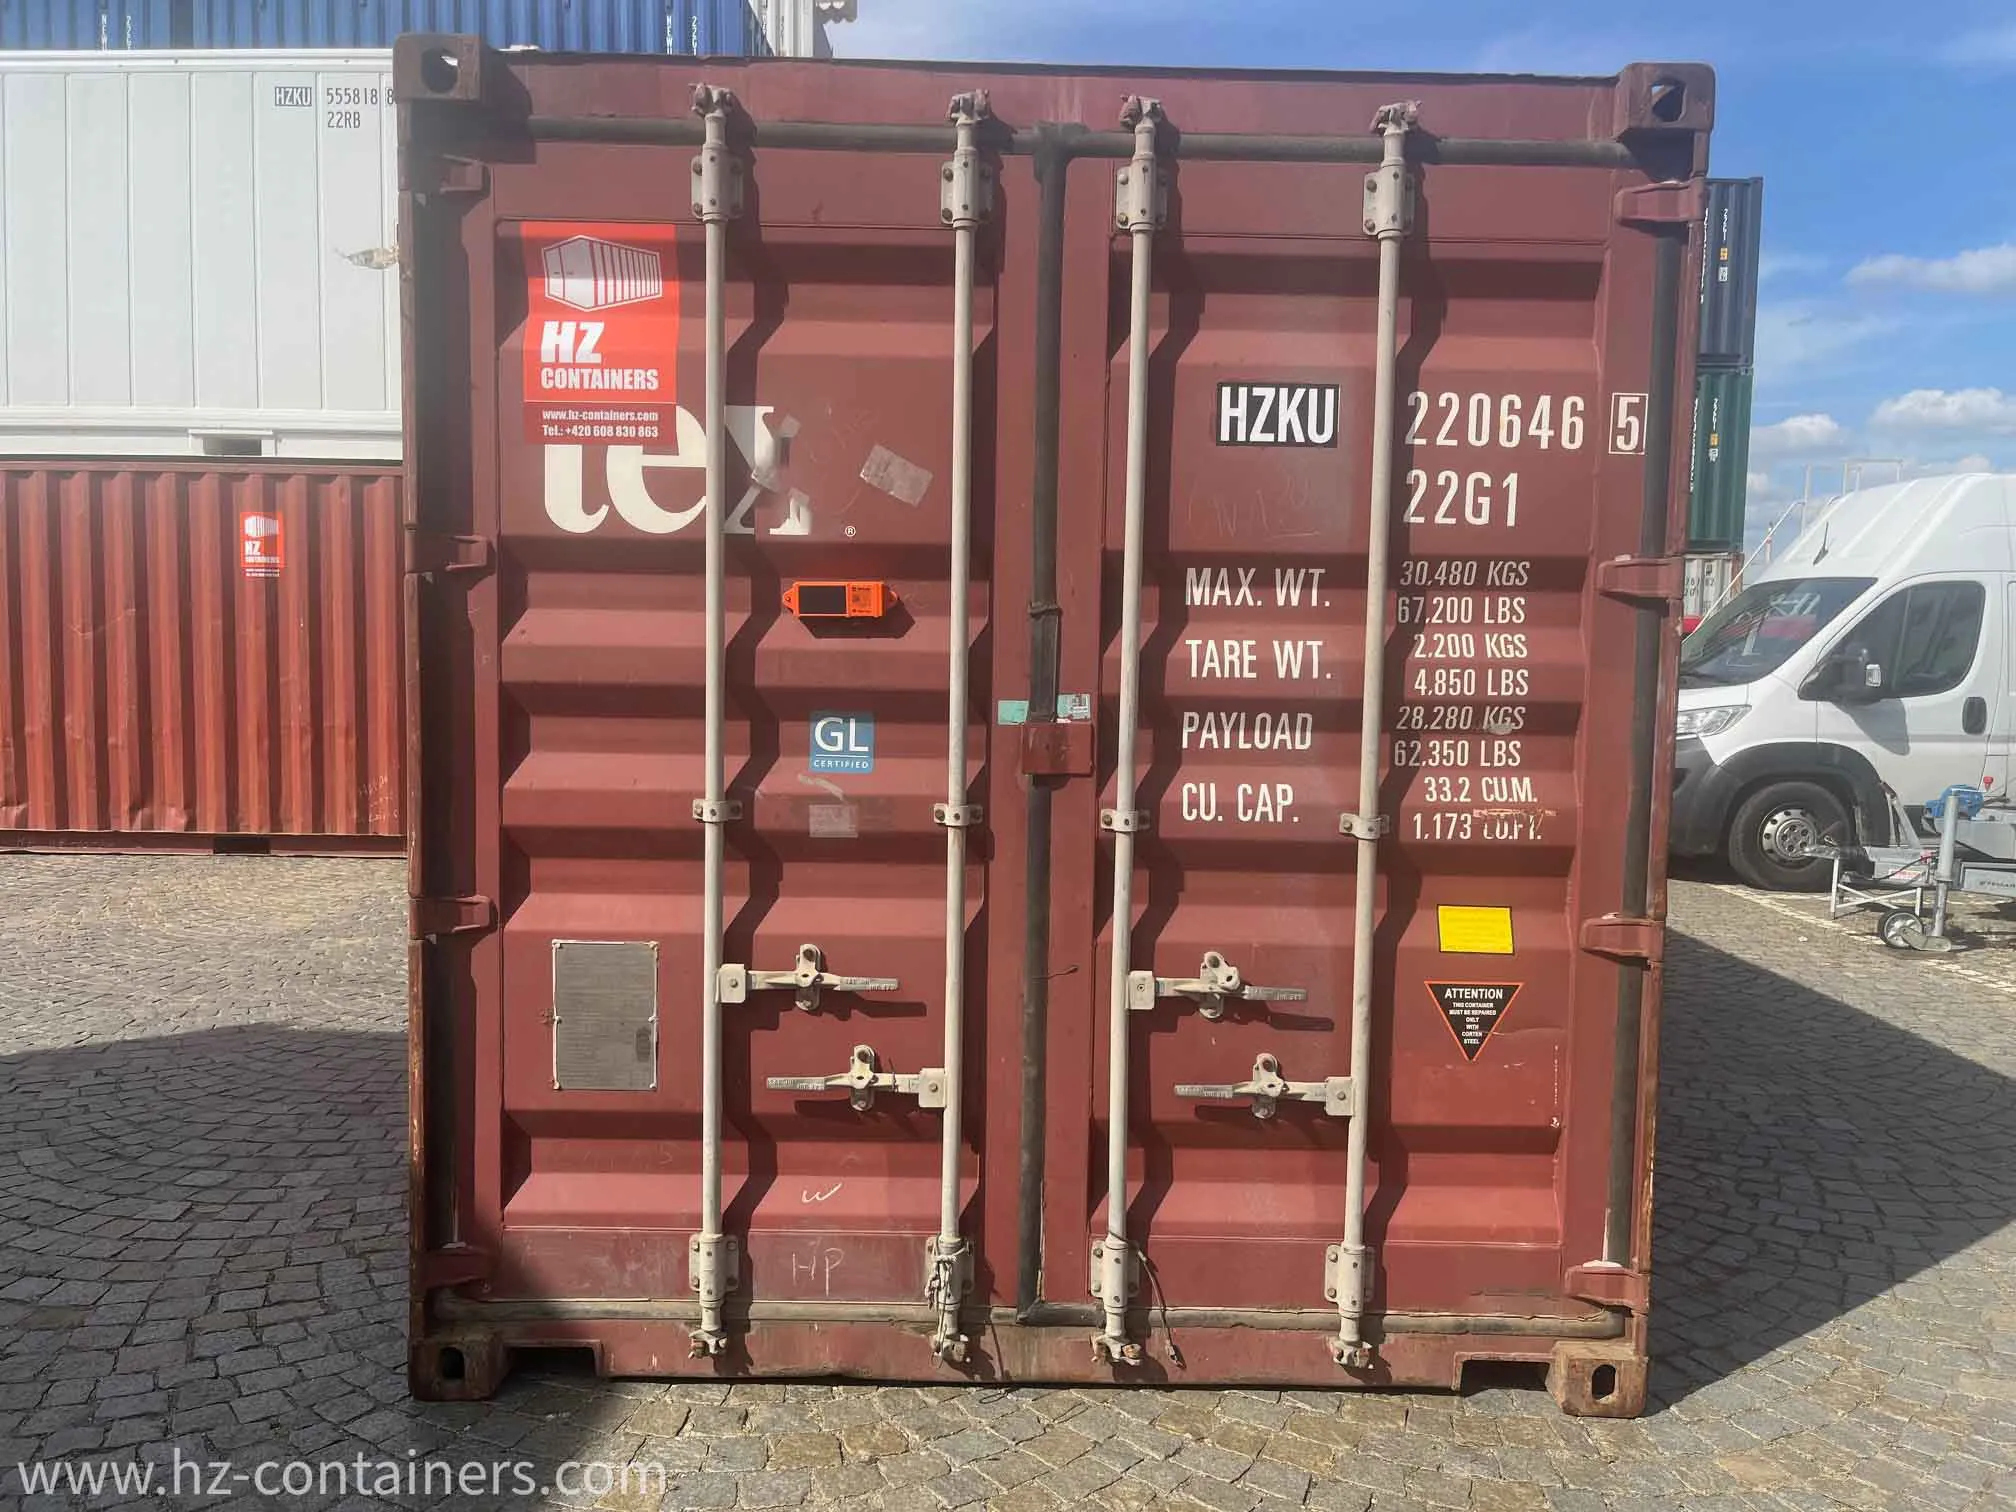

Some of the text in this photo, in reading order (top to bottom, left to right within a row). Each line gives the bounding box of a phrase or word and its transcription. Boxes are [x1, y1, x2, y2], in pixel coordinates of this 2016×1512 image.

[275, 87, 312, 106] HZKU
[326, 87, 378, 105] 555818
[327, 111, 361, 129] 22RB
[541, 321, 605, 363] HZ
[541, 367, 659, 390] CONTAINERS
[542, 408, 659, 421] www.hz-containers.com
[1219, 386, 1335, 444] HZKU
[1405, 391, 1585, 450] 220646
[1614, 395, 1642, 452] 5
[542, 424, 659, 438] Tel.: +420 608 830 863
[1403, 469, 1519, 527] 22G1
[1400, 561, 1531, 586] 30,480 KGS
[1185, 568, 1330, 607] MAX. WT.
[1398, 596, 1526, 624] 67,200 LBS
[1185, 639, 1332, 679] TARE WT.
[1414, 633, 1528, 658] 2,200 KGS
[1414, 668, 1529, 696] 4,850 LBS
[1182, 712, 1313, 750] PAYLOAD
[1396, 705, 1526, 731] 28,280 KGS
[815, 717, 869, 752] GL
[813, 760, 869, 769] CERTIFIED
[1394, 740, 1522, 767] 62,350 LBS
[1182, 783, 1299, 822] CU. CAP.
[1424, 776, 1538, 802] 33.2 CU.M.
[1413, 813, 1472, 840] 1,173
[1444, 987, 1503, 999] ATTENTION
